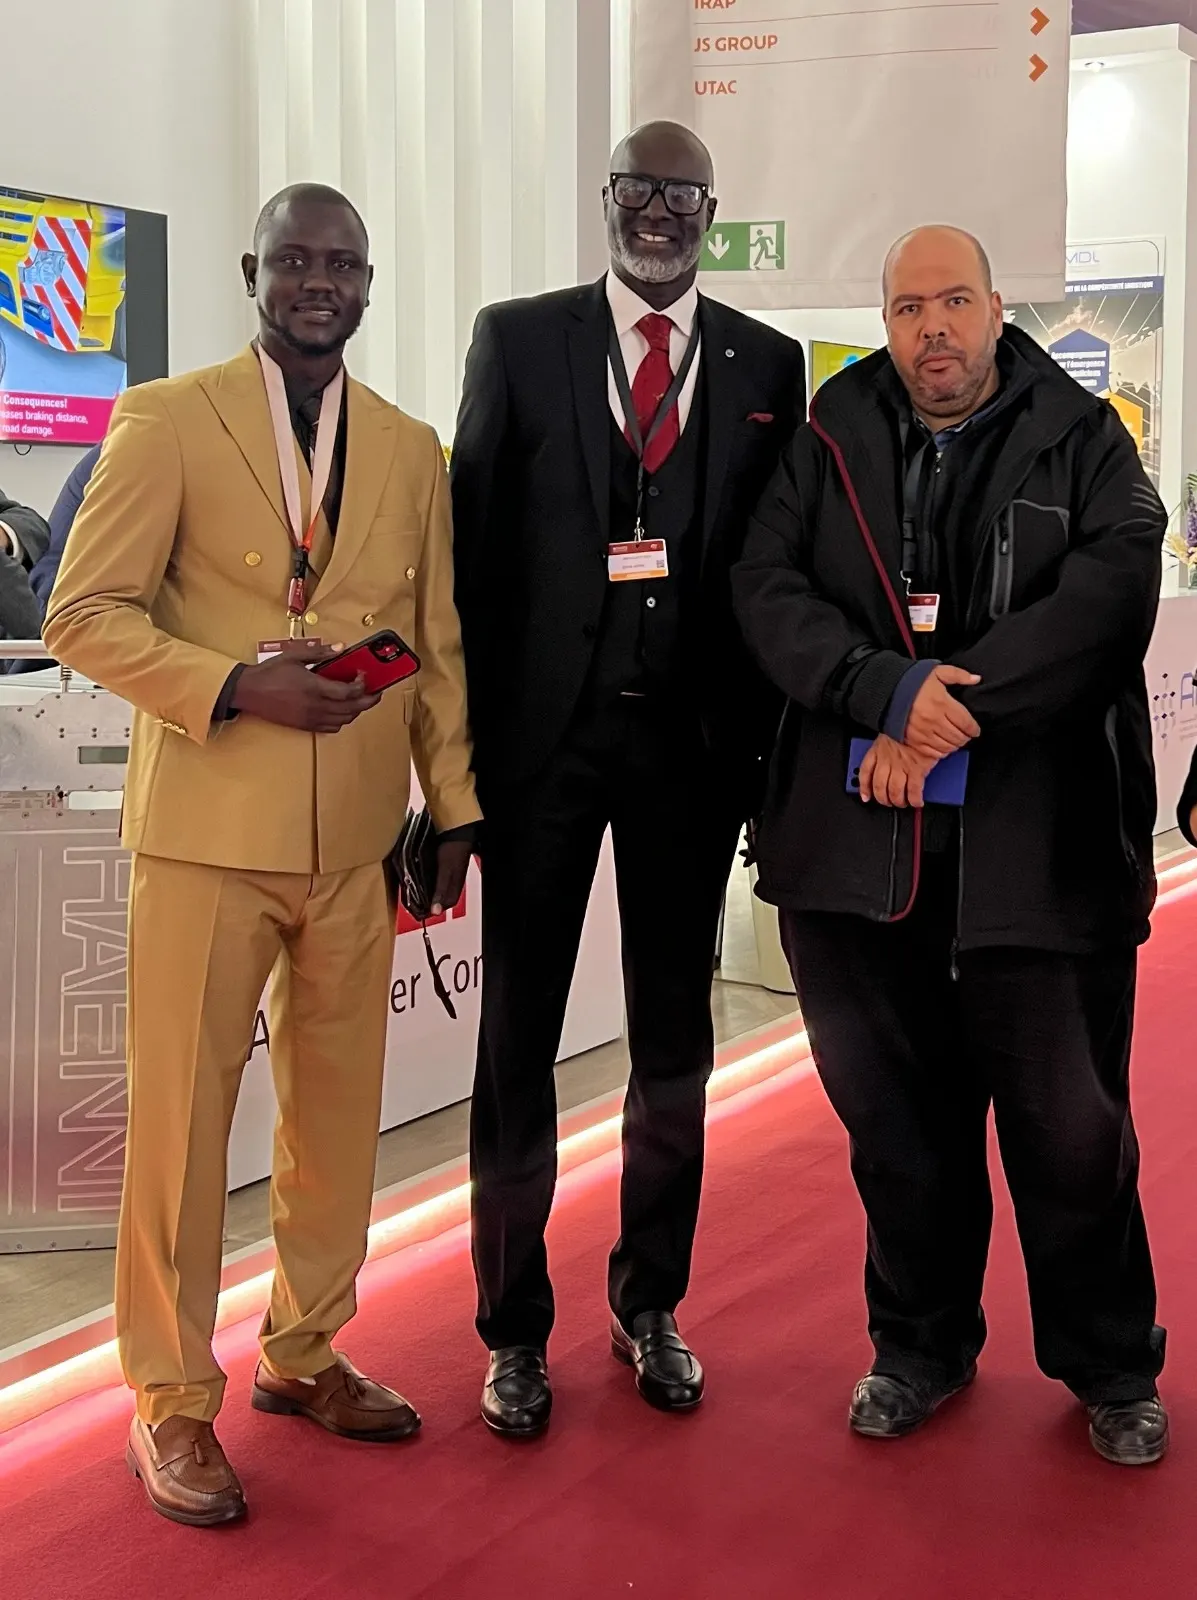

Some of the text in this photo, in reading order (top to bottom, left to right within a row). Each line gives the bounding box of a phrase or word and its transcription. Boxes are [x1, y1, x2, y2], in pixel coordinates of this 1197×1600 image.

[694, 34, 778, 52] JS GROUP
[694, 80, 737, 95] UTAC
[3, 394, 68, 409] Consequences!
[25, 410, 54, 423] braking
[55, 412, 89, 424] distance,
[2, 423, 54, 437] road damage.
